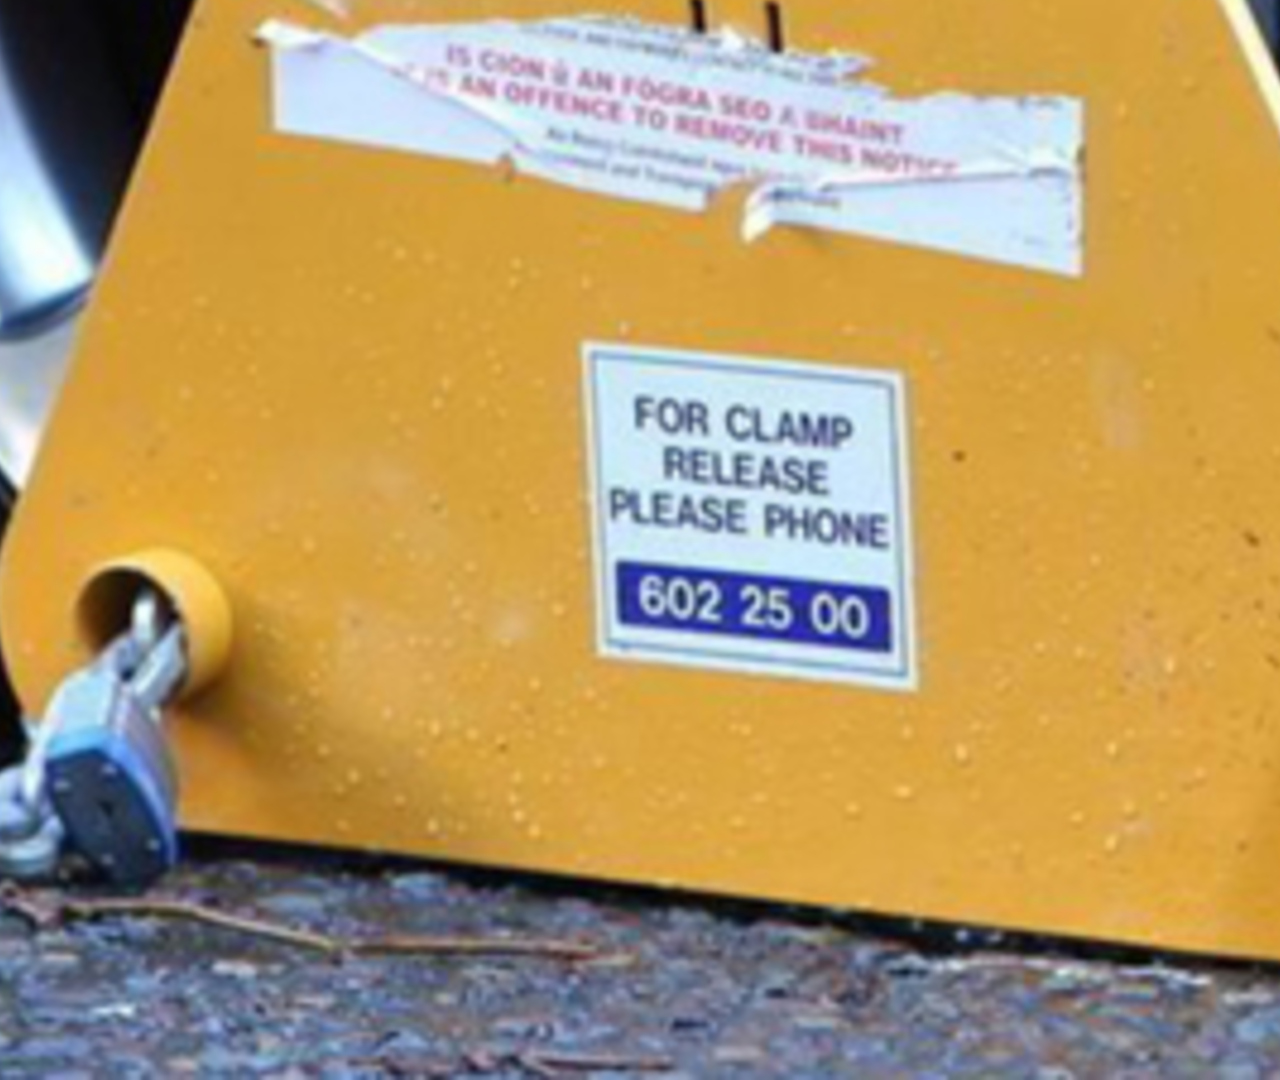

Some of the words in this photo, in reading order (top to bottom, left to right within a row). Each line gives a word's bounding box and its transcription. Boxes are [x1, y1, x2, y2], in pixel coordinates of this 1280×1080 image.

[446, 43, 471, 68] IS
[577, 66, 614, 95] AN
[504, 80, 623, 121] OFFENCE
[634, 103, 668, 131] TO
[674, 111, 782, 154] REMOVE
[793, 133, 853, 165] THIS
[634, 395, 710, 437] FOR
[725, 404, 854, 449] CLAMP
[663, 445, 830, 497] RELEASE
[609, 487, 749, 535] PLEASE
[763, 503, 890, 551] PHONE
[638, 574, 721, 622] 602
[740, 584, 793, 631] 25
[810, 592, 870, 639] 00
